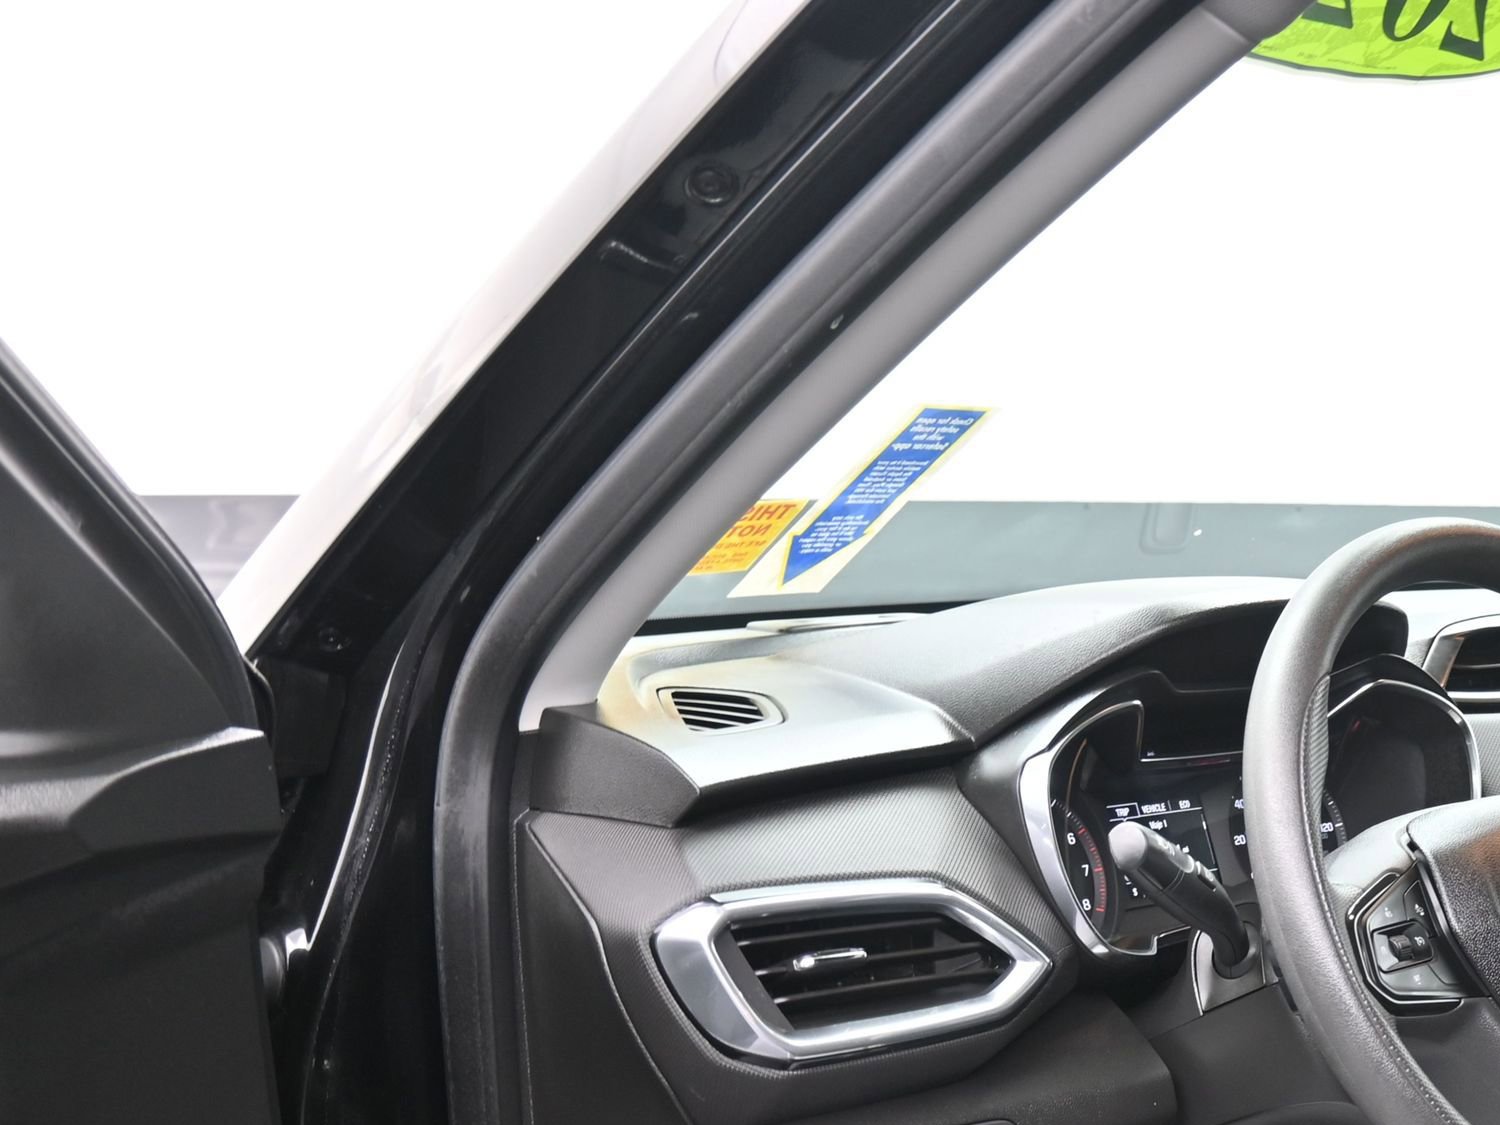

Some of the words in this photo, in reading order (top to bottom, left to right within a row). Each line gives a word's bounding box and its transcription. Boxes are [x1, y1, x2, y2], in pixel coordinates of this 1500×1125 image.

[1141, 802, 1167, 814] VEHICLE
[1067, 832, 1076, 845] 6
[1233, 834, 1247, 845] 20
[1081, 864, 1090, 877] 7
[1082, 898, 1091, 911] 8
